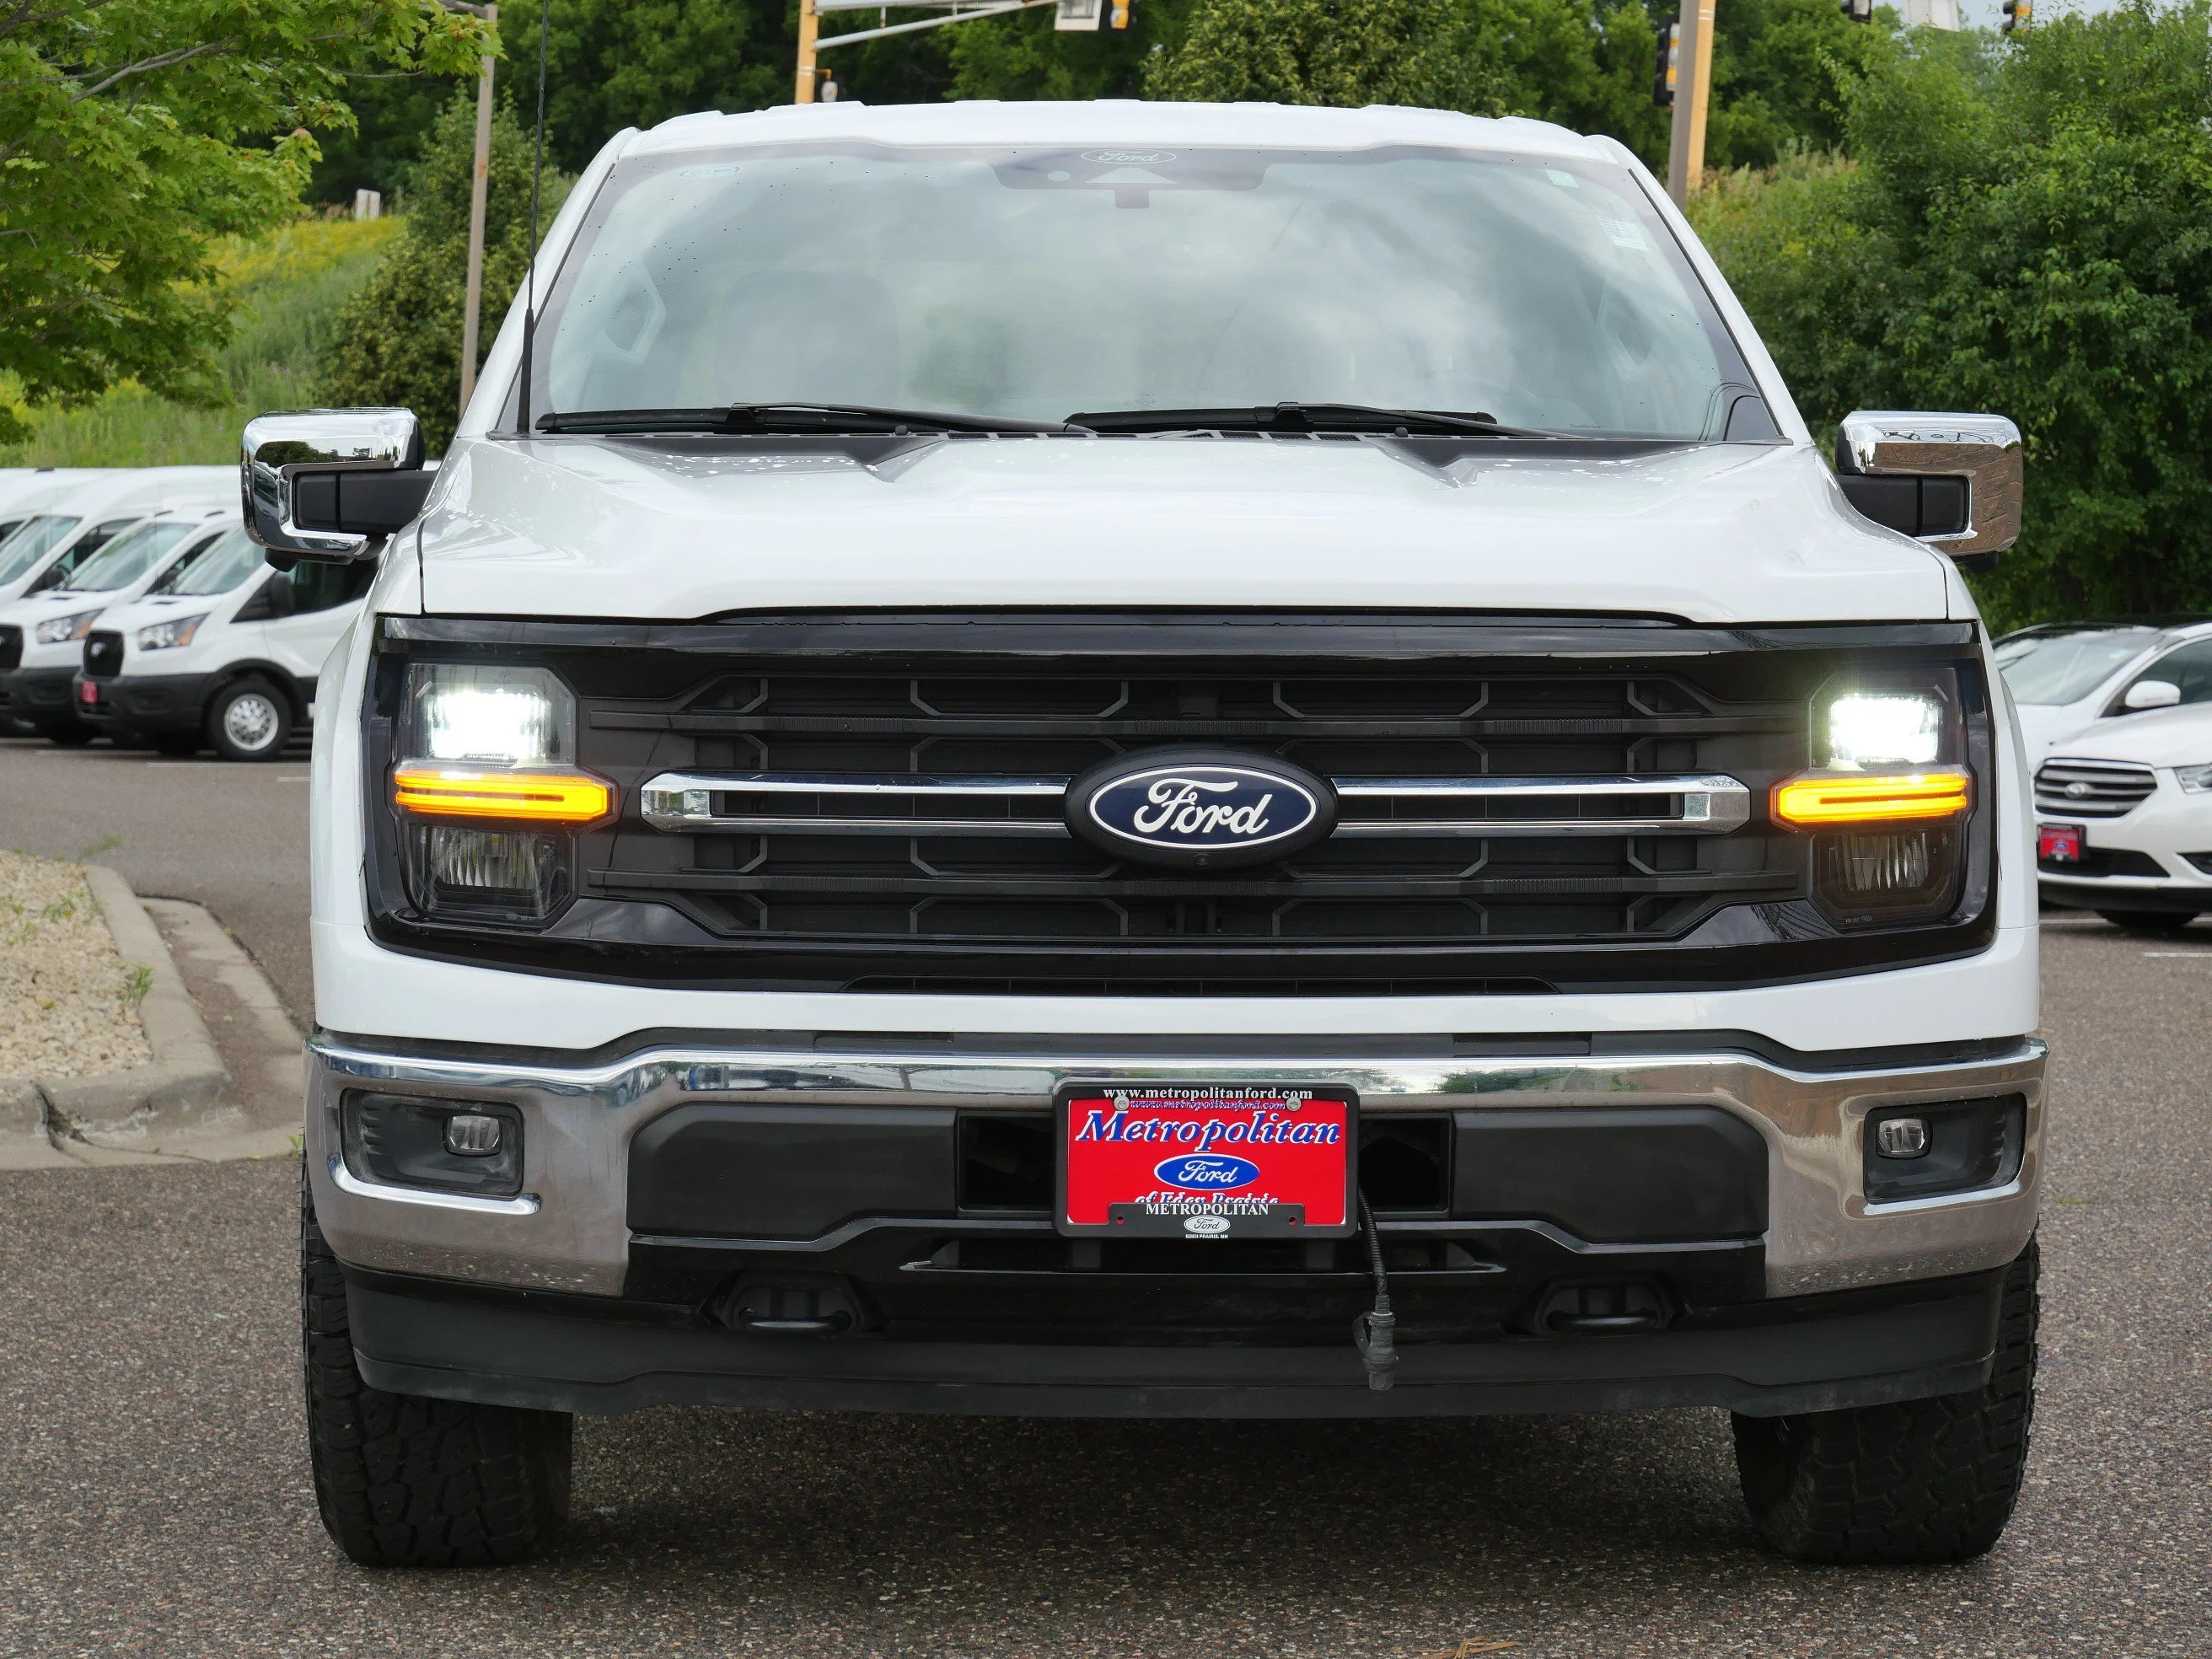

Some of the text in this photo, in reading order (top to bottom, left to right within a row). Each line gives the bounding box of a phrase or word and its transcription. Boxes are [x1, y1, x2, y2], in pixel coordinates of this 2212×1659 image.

[1098, 150, 1160, 162] Ford
[1134, 778, 1273, 835] Ford
[1103, 1087, 1313, 1102] www.metropolitanford.com
[1075, 1109, 1340, 1152] Metropolitan
[1178, 1159, 1238, 1184] Ford
[1146, 1203, 1270, 1215] METROPOLITAN
[1194, 1217, 1221, 1230] Ford
